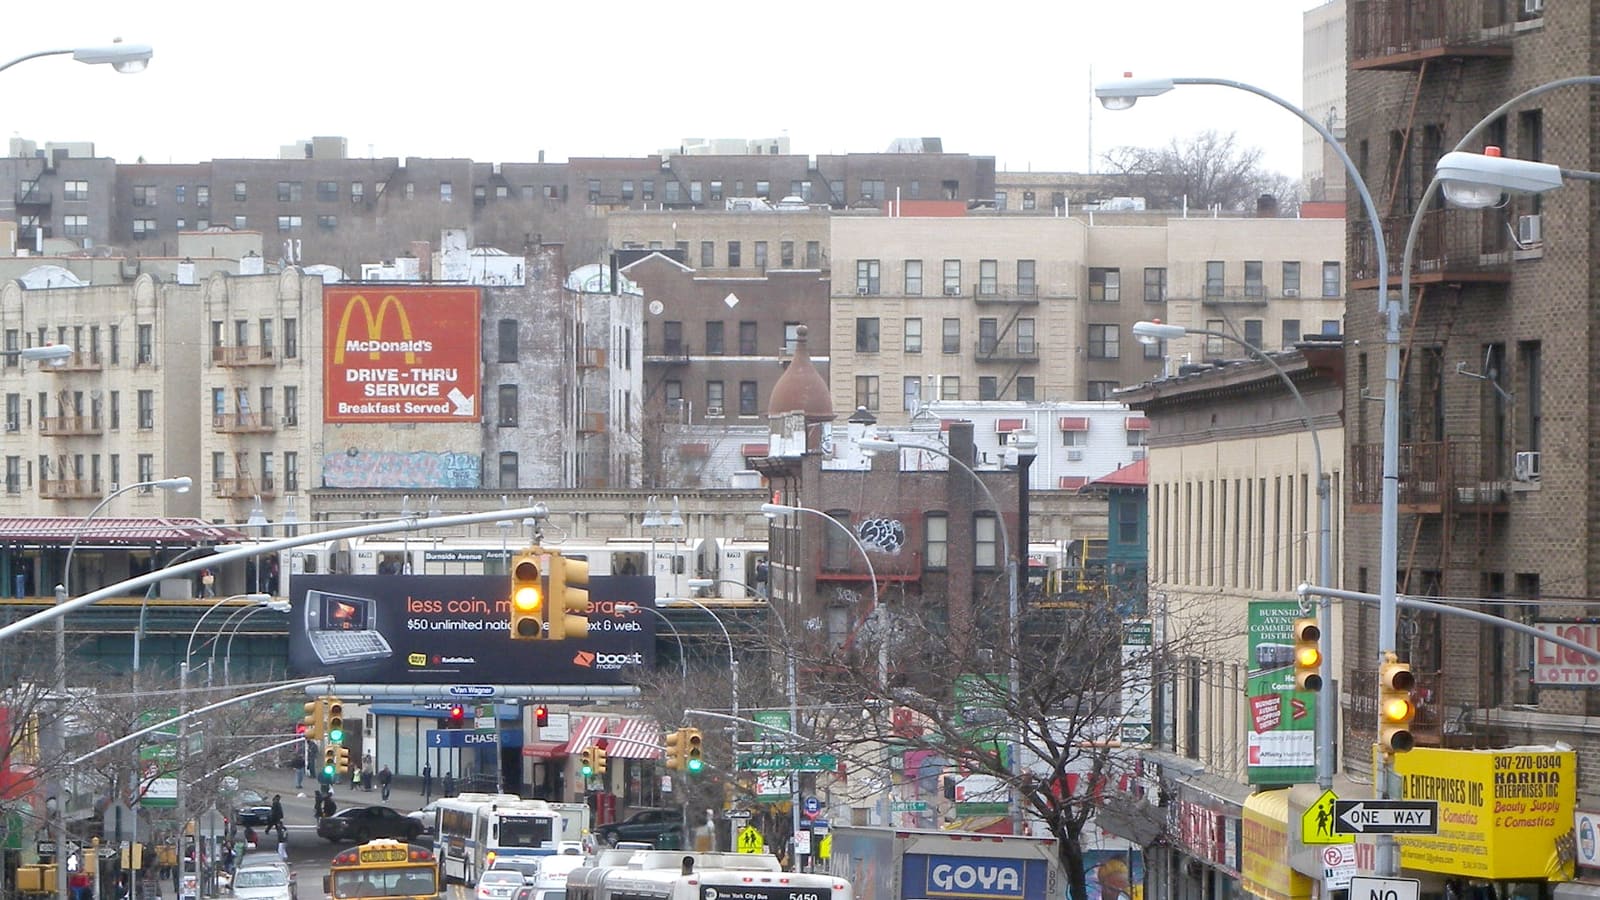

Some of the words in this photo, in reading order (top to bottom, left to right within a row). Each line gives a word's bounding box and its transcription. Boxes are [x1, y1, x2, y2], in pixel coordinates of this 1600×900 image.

[346, 340, 432, 352] McDonald's
[346, 369, 398, 381] DRIVE
[410, 369, 458, 381] THRU
[364, 384, 439, 396] SERVICE
[339, 402, 400, 414] Breakfast
[404, 402, 449, 414] Served
[407, 596, 442, 613] less
[447, 596, 491, 616] coin,
[408, 619, 428, 631] $50
[430, 619, 482, 630] unlimited
[586, 620, 601, 631] ext
[614, 620, 642, 631] web.
[596, 652, 642, 664] boost
[1538, 668, 1598, 682] LOTTO
[1494, 756, 1561, 770] 347-270-0344
[1495, 772, 1560, 784] KARINA
[1410, 774, 1466, 804] ENTERPRISES
[1468, 781, 1484, 807] INC
[1495, 784, 1543, 798] ENTERPRISES
[1546, 784, 1558, 798] INC
[1494, 801, 1526, 814] Beauty
[1530, 800, 1560, 813] Supply
[1351, 811, 1380, 824] ONE
[1394, 811, 1424, 824] WAY
[932, 864, 1018, 891] GOYA
